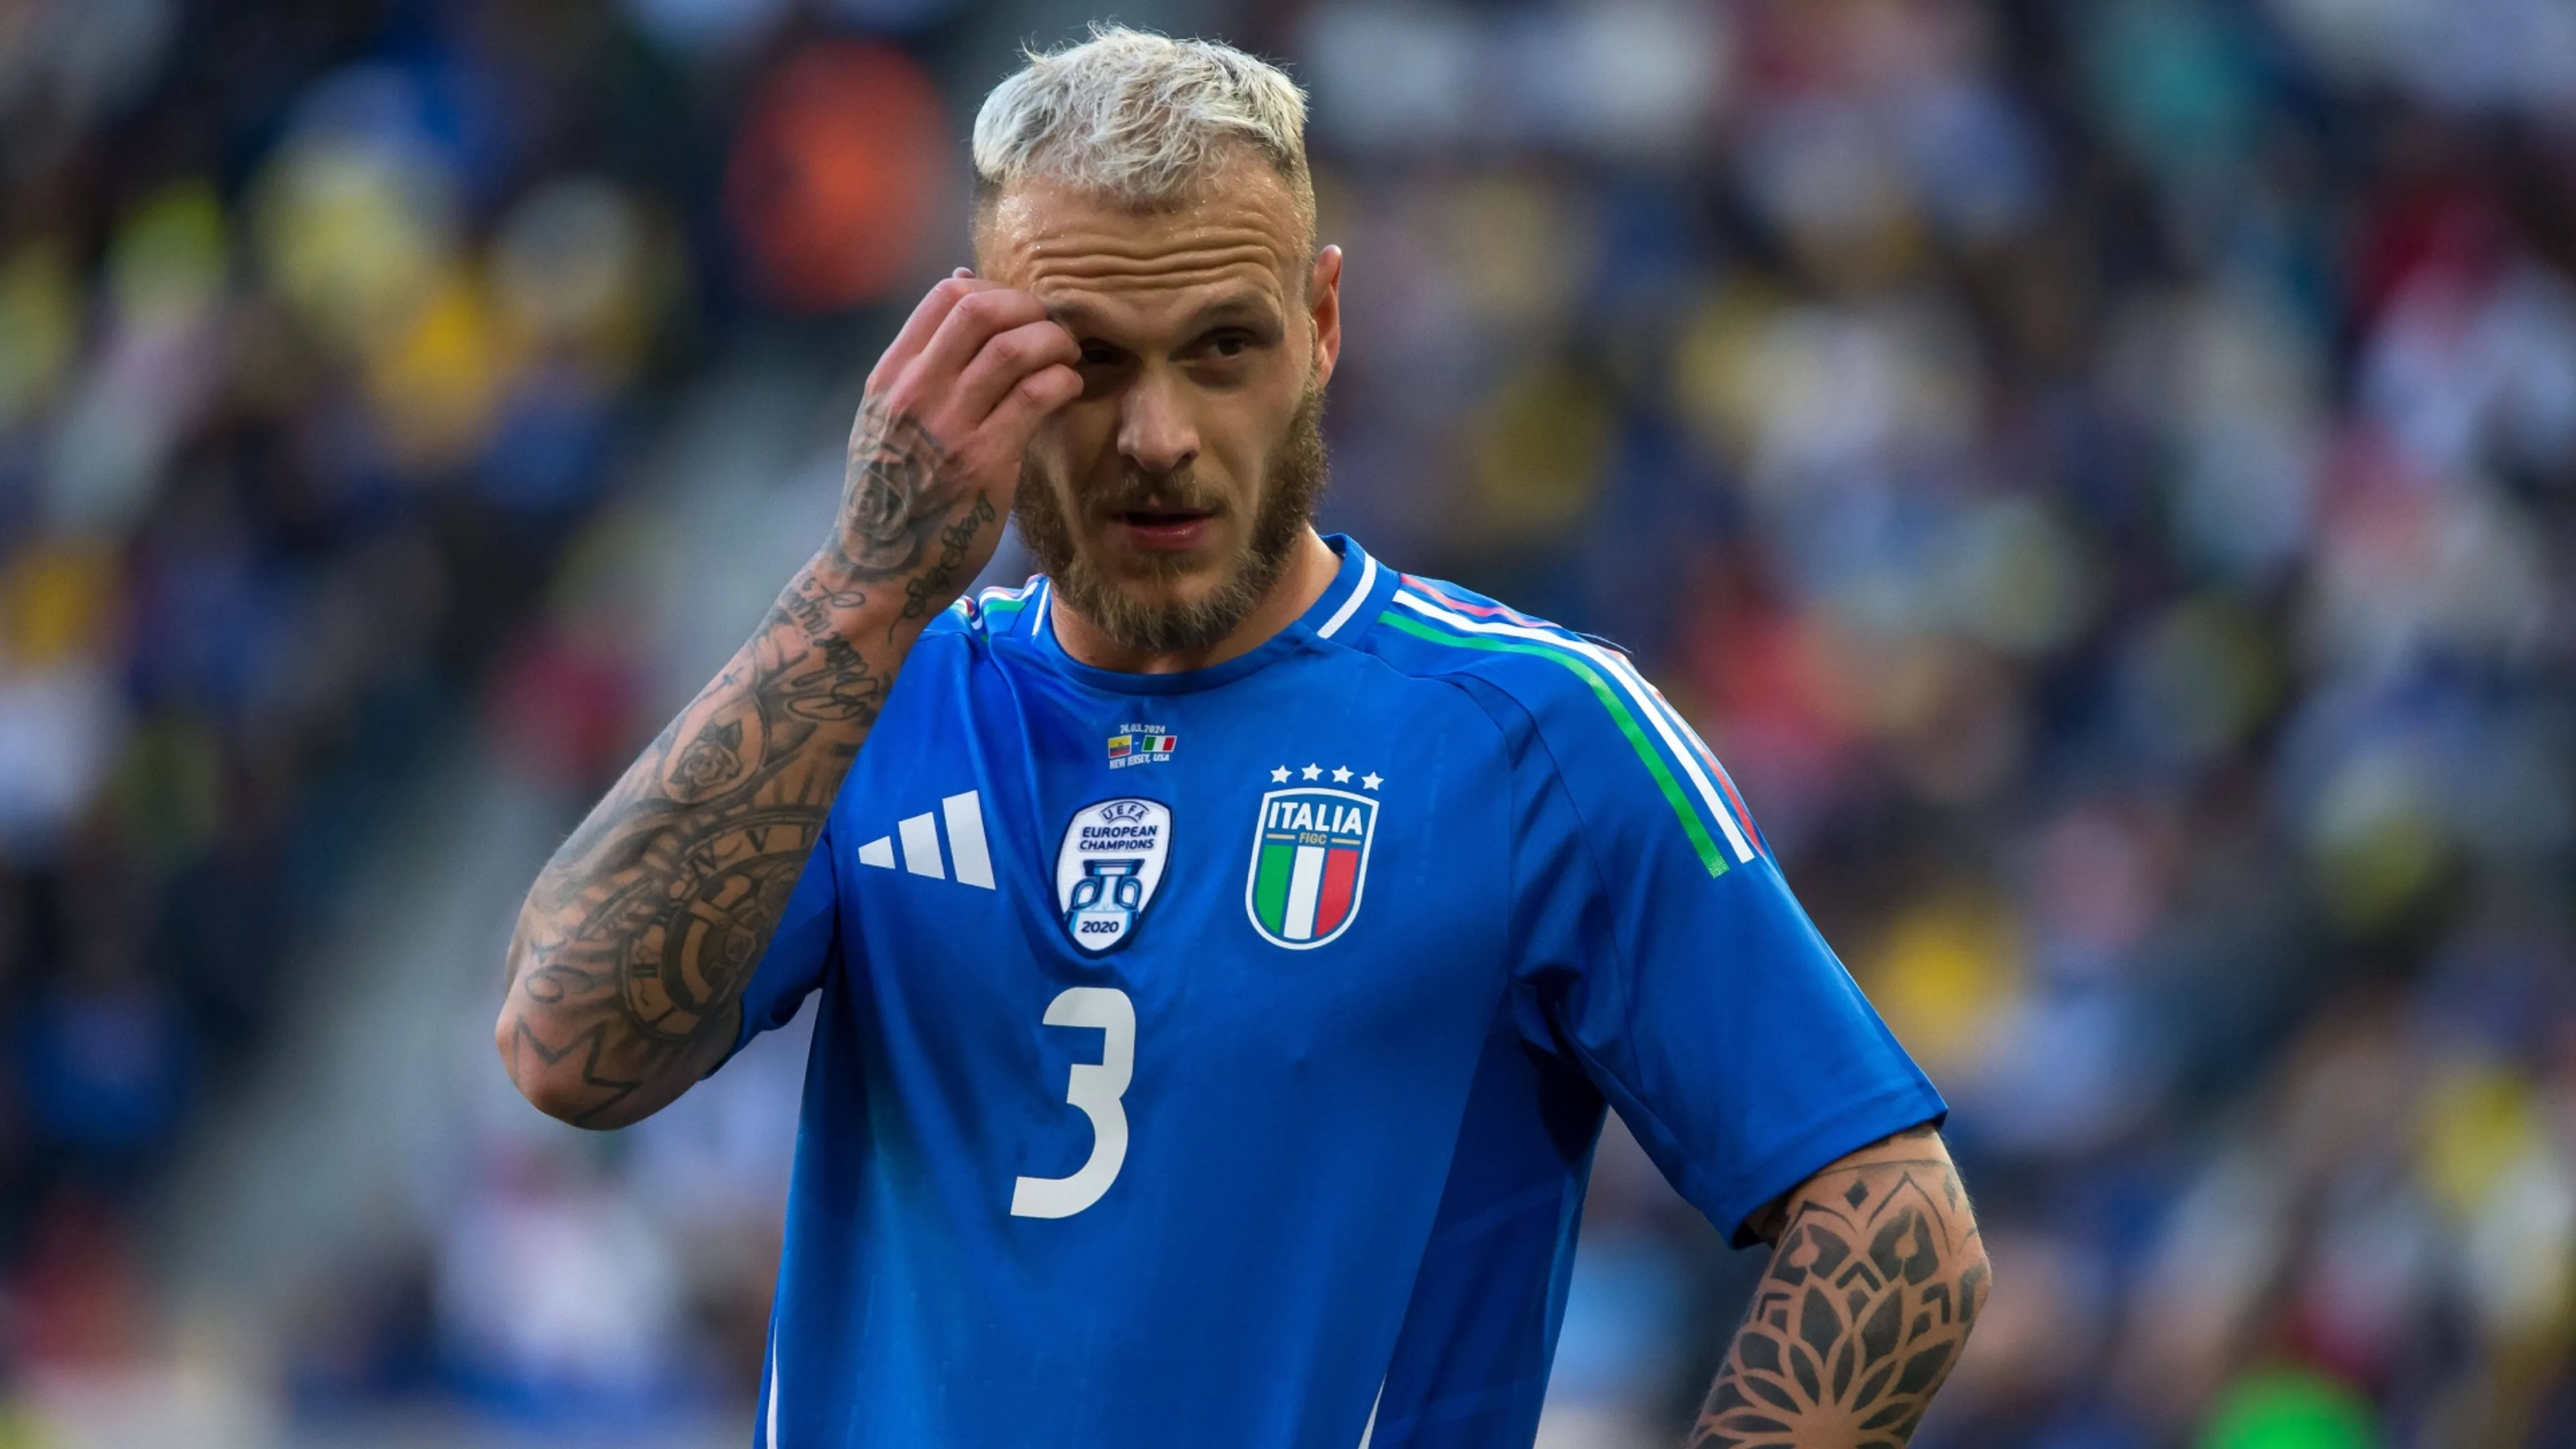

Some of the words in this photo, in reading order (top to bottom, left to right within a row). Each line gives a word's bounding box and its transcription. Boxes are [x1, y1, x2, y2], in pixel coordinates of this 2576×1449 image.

[1110, 757, 1126, 769] NEW
[1152, 753, 1169, 761] USA
[1103, 805, 1145, 820] UEFA
[1268, 802, 1362, 835] ITALIA
[1083, 825, 1158, 838] EUROPEAN
[1299, 832, 1328, 845] FIGC
[1080, 839, 1155, 850] CHAMPIONS
[1081, 921, 1119, 934] 2020
[1010, 987, 1136, 1219] 3
